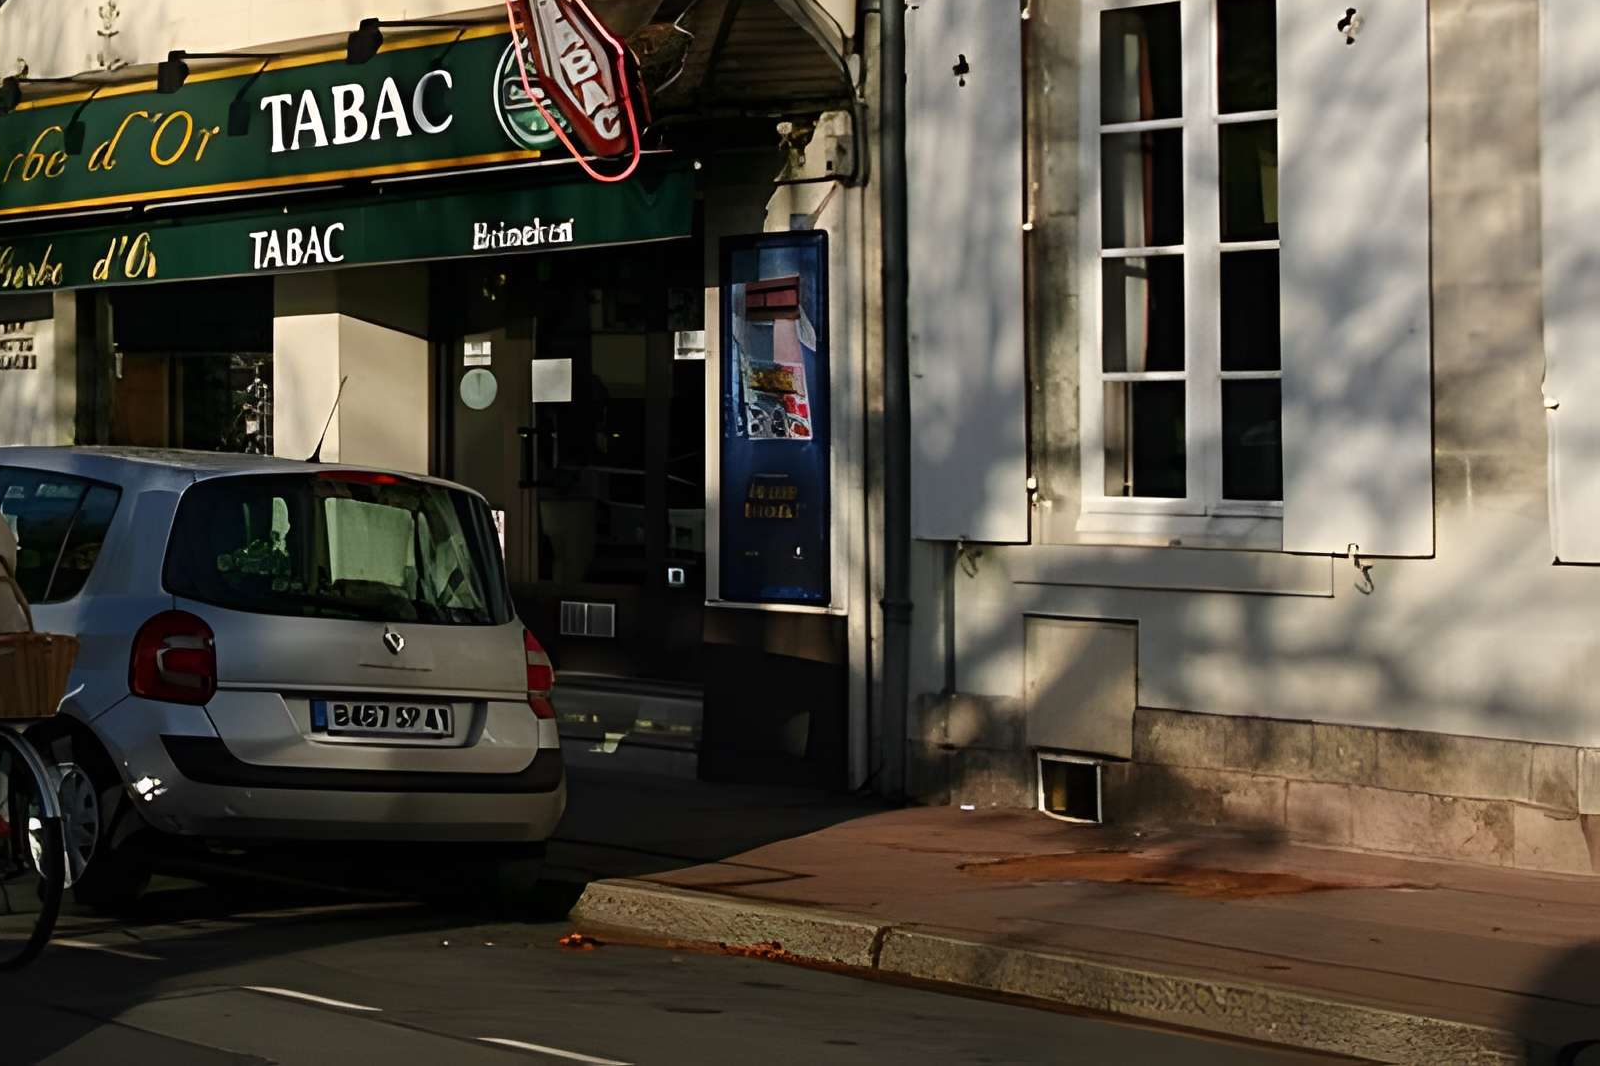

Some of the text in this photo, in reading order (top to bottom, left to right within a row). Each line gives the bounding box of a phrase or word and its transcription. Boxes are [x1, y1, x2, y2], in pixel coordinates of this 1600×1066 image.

[88, 109, 221, 173] d'Or
[260, 68, 453, 153] TABAC
[249, 222, 344, 270] TABAC
